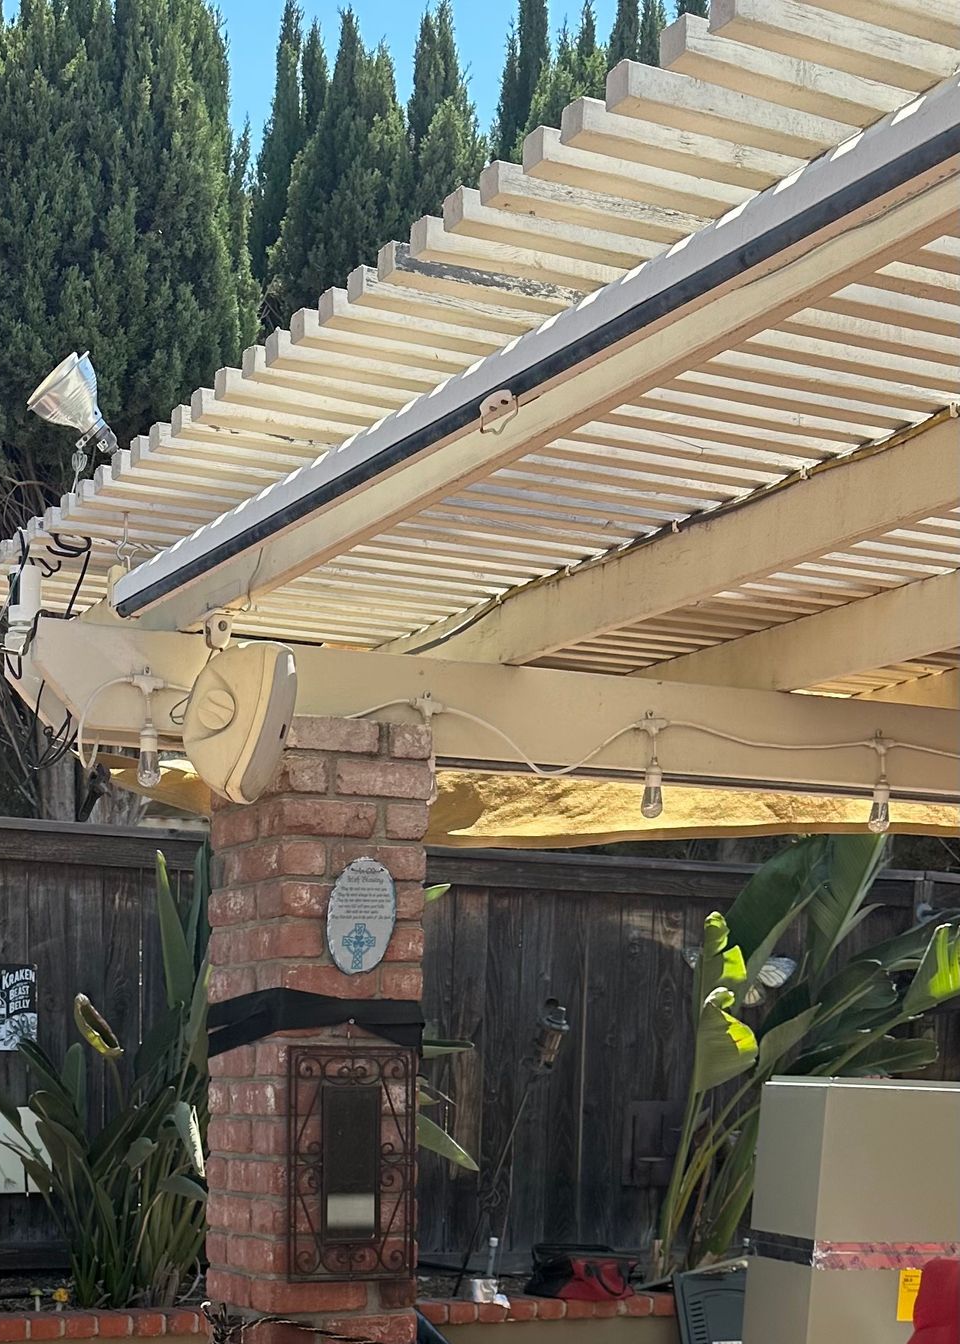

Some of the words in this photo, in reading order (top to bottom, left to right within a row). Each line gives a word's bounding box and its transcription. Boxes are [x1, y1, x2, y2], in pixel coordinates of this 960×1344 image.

[2, 969, 35, 989] KRAKEN
[9, 985, 30, 1000] BEAST
[9, 999, 30, 1014] BELLY
